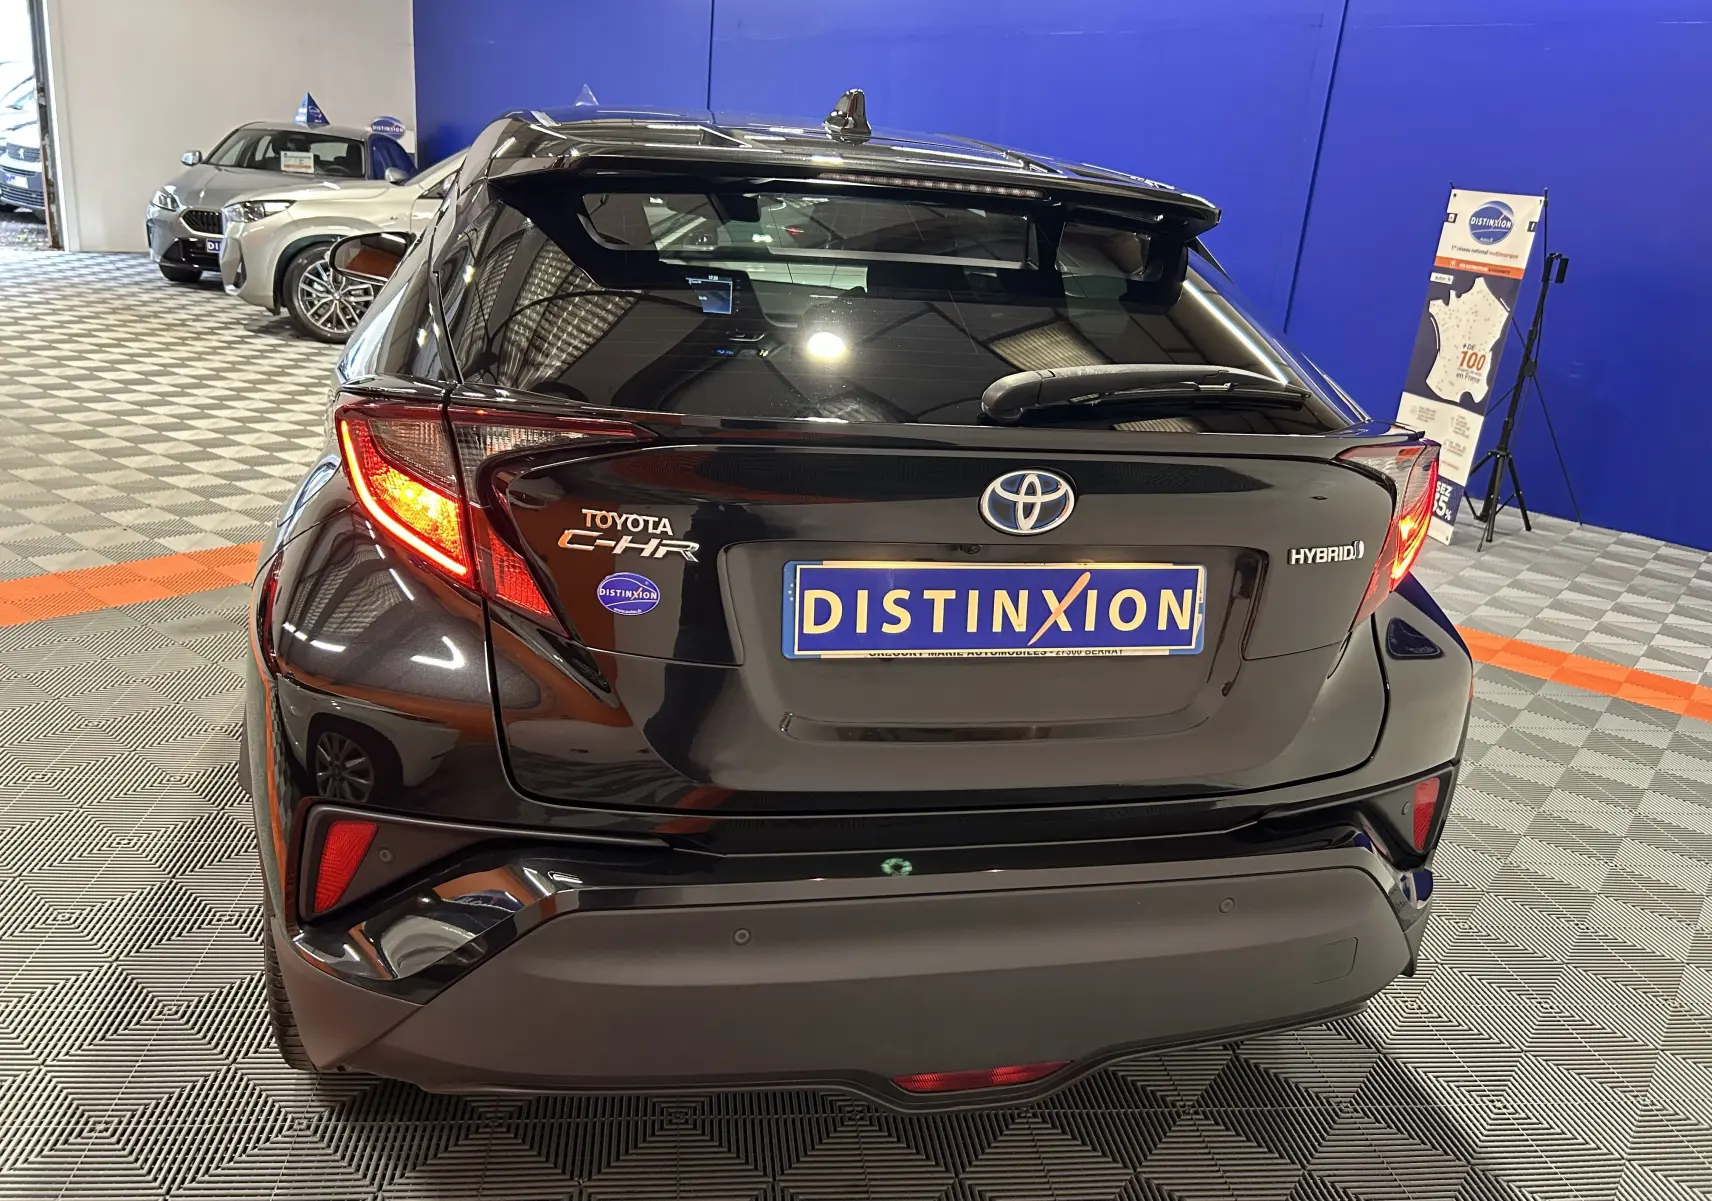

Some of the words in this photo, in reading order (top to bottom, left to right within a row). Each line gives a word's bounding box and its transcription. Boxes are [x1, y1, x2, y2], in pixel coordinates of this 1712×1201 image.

[372, 123, 404, 133] DISTINXION
[1470, 214, 1512, 229] DISTINXION
[1471, 247, 1489, 256] national
[1467, 343, 1476, 351] DE
[1460, 350, 1486, 371] 100
[1464, 373, 1480, 385] France
[581, 508, 674, 536] TOYOTA
[557, 529, 700, 563] C-HR
[1289, 544, 1356, 565] HYBRID
[599, 587, 658, 600] DISTINXION
[802, 571, 1193, 646] DISTINXION
